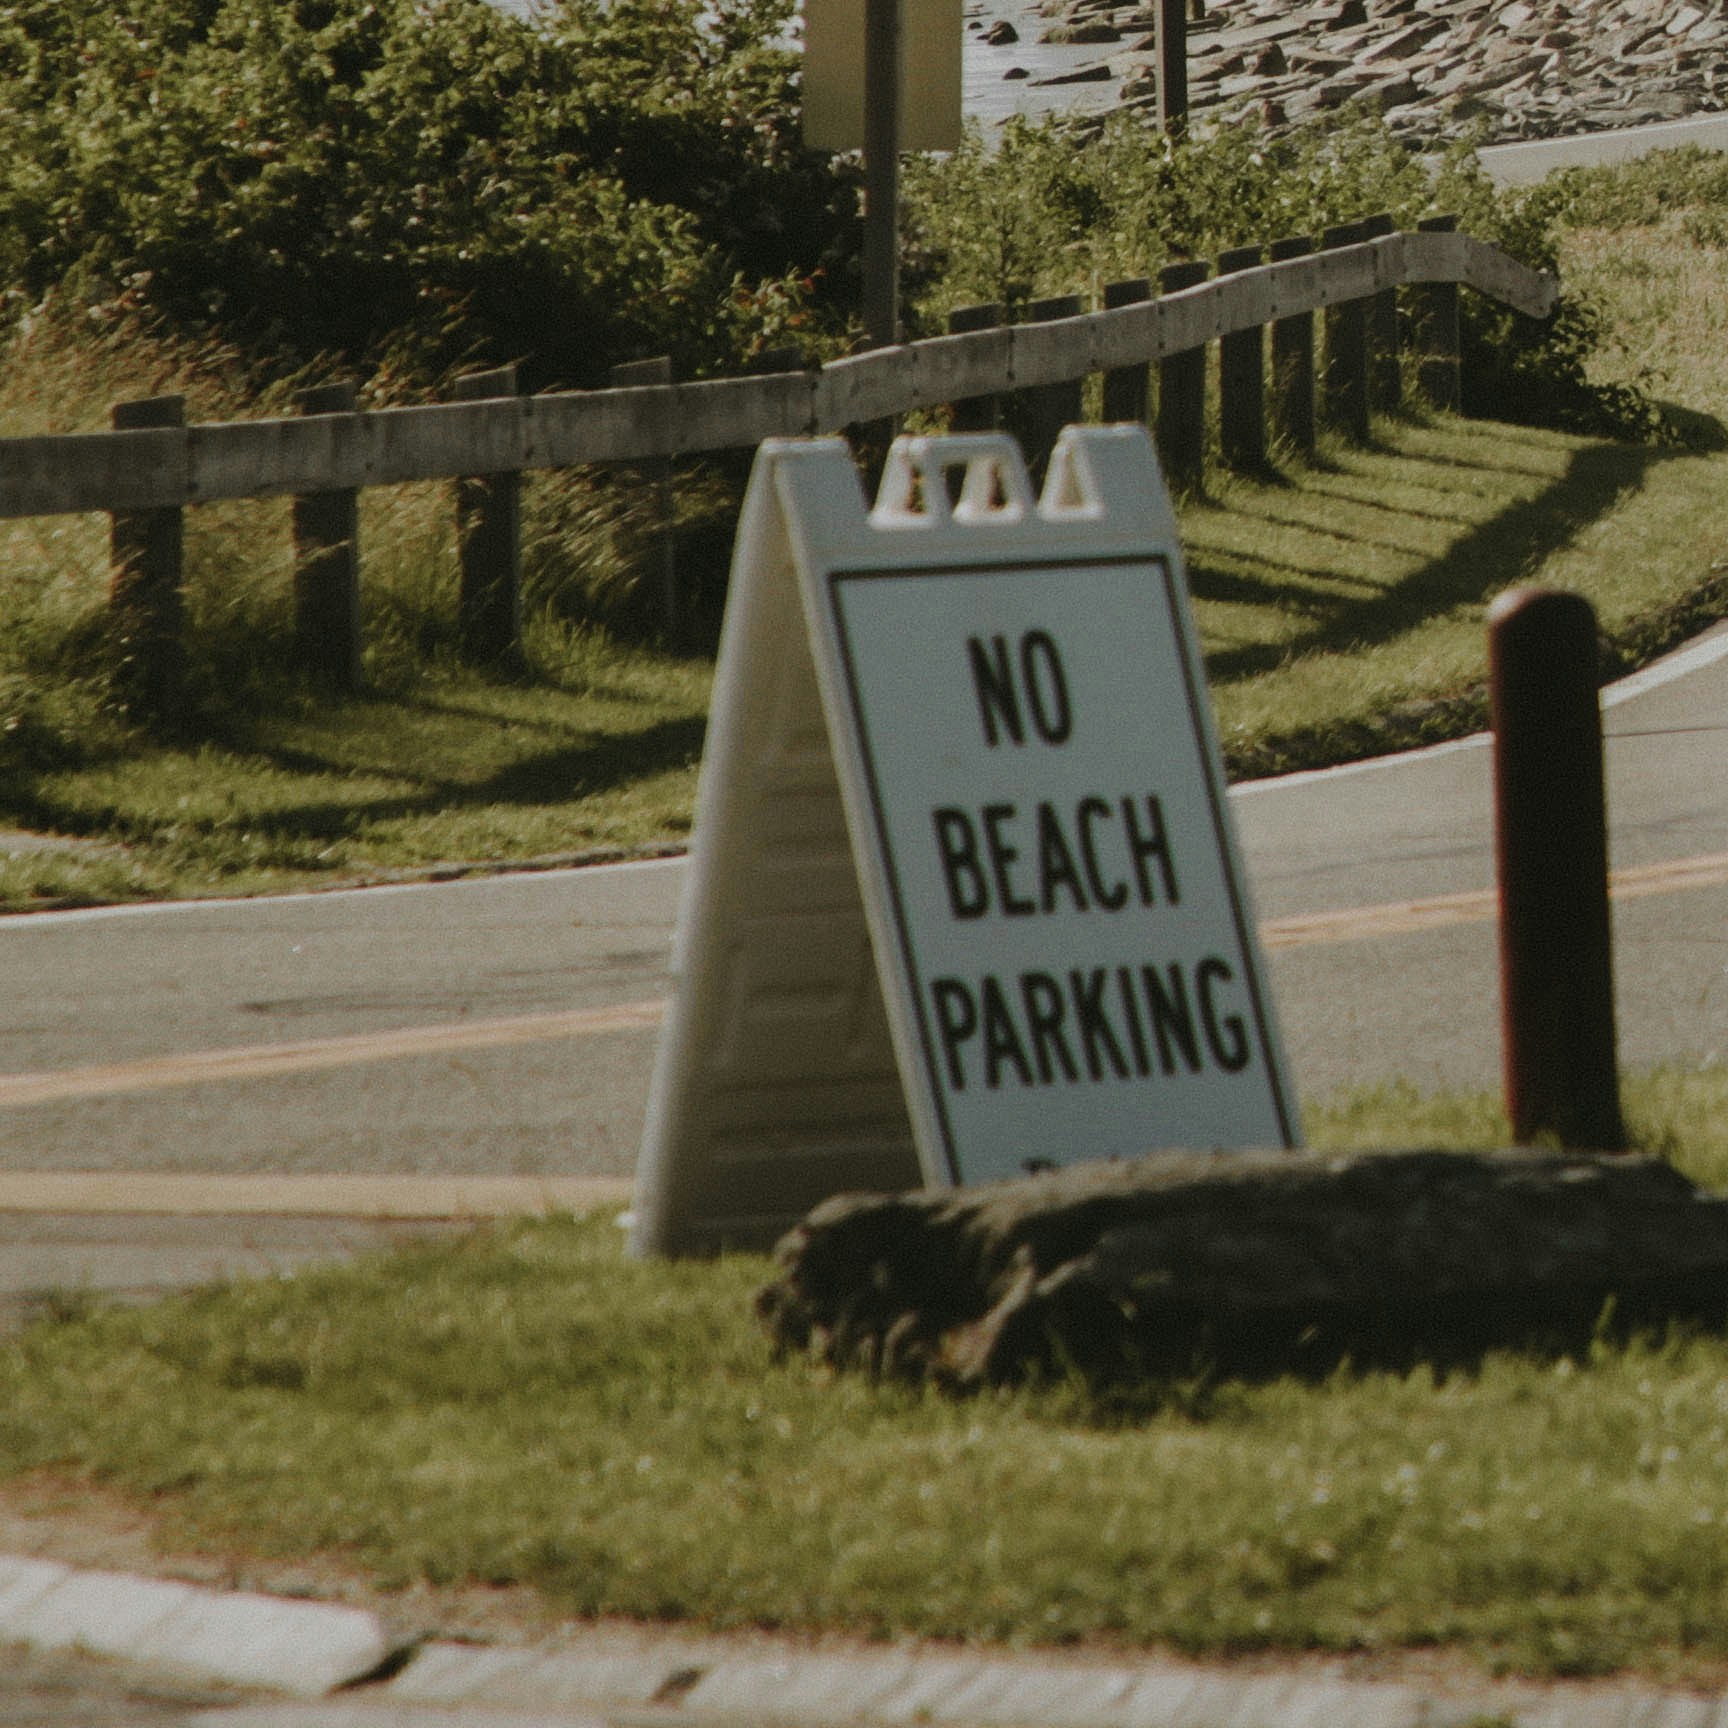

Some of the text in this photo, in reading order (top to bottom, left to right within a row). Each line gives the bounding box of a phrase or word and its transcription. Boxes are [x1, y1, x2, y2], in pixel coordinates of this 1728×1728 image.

[967, 628, 1072, 748] NO
[931, 794, 1181, 921] BEACH
[929, 955, 1252, 1093] PARKING
